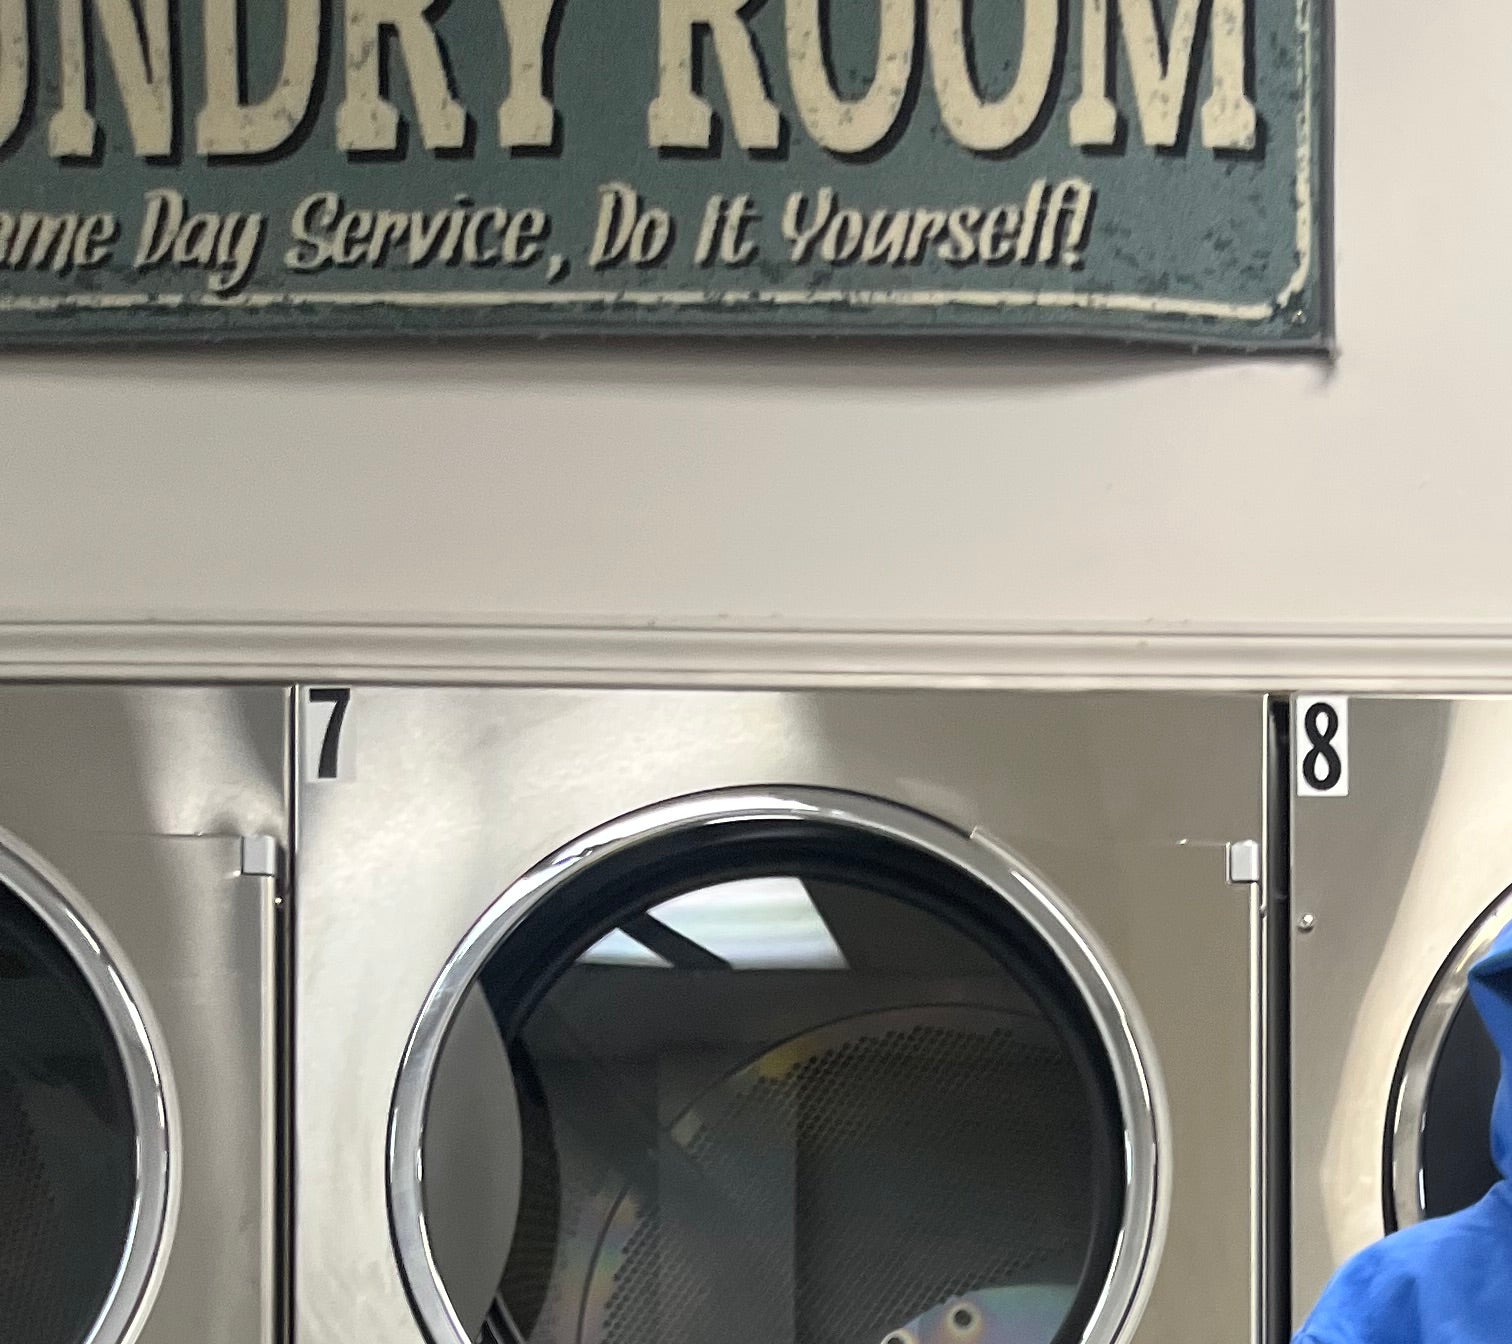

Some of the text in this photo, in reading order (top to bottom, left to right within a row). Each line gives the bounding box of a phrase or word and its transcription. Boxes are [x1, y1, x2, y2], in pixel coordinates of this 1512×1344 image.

[0, 0, 567, 157] NDRY
[133, 188, 262, 293] Day
[284, 191, 568, 282] Service,
[588, 181, 670, 268] Do
[694, 194, 763, 264] It
[780, 177, 1095, 270] Yourself!
[309, 687, 351, 779] 7
[1302, 702, 1342, 791] 8
